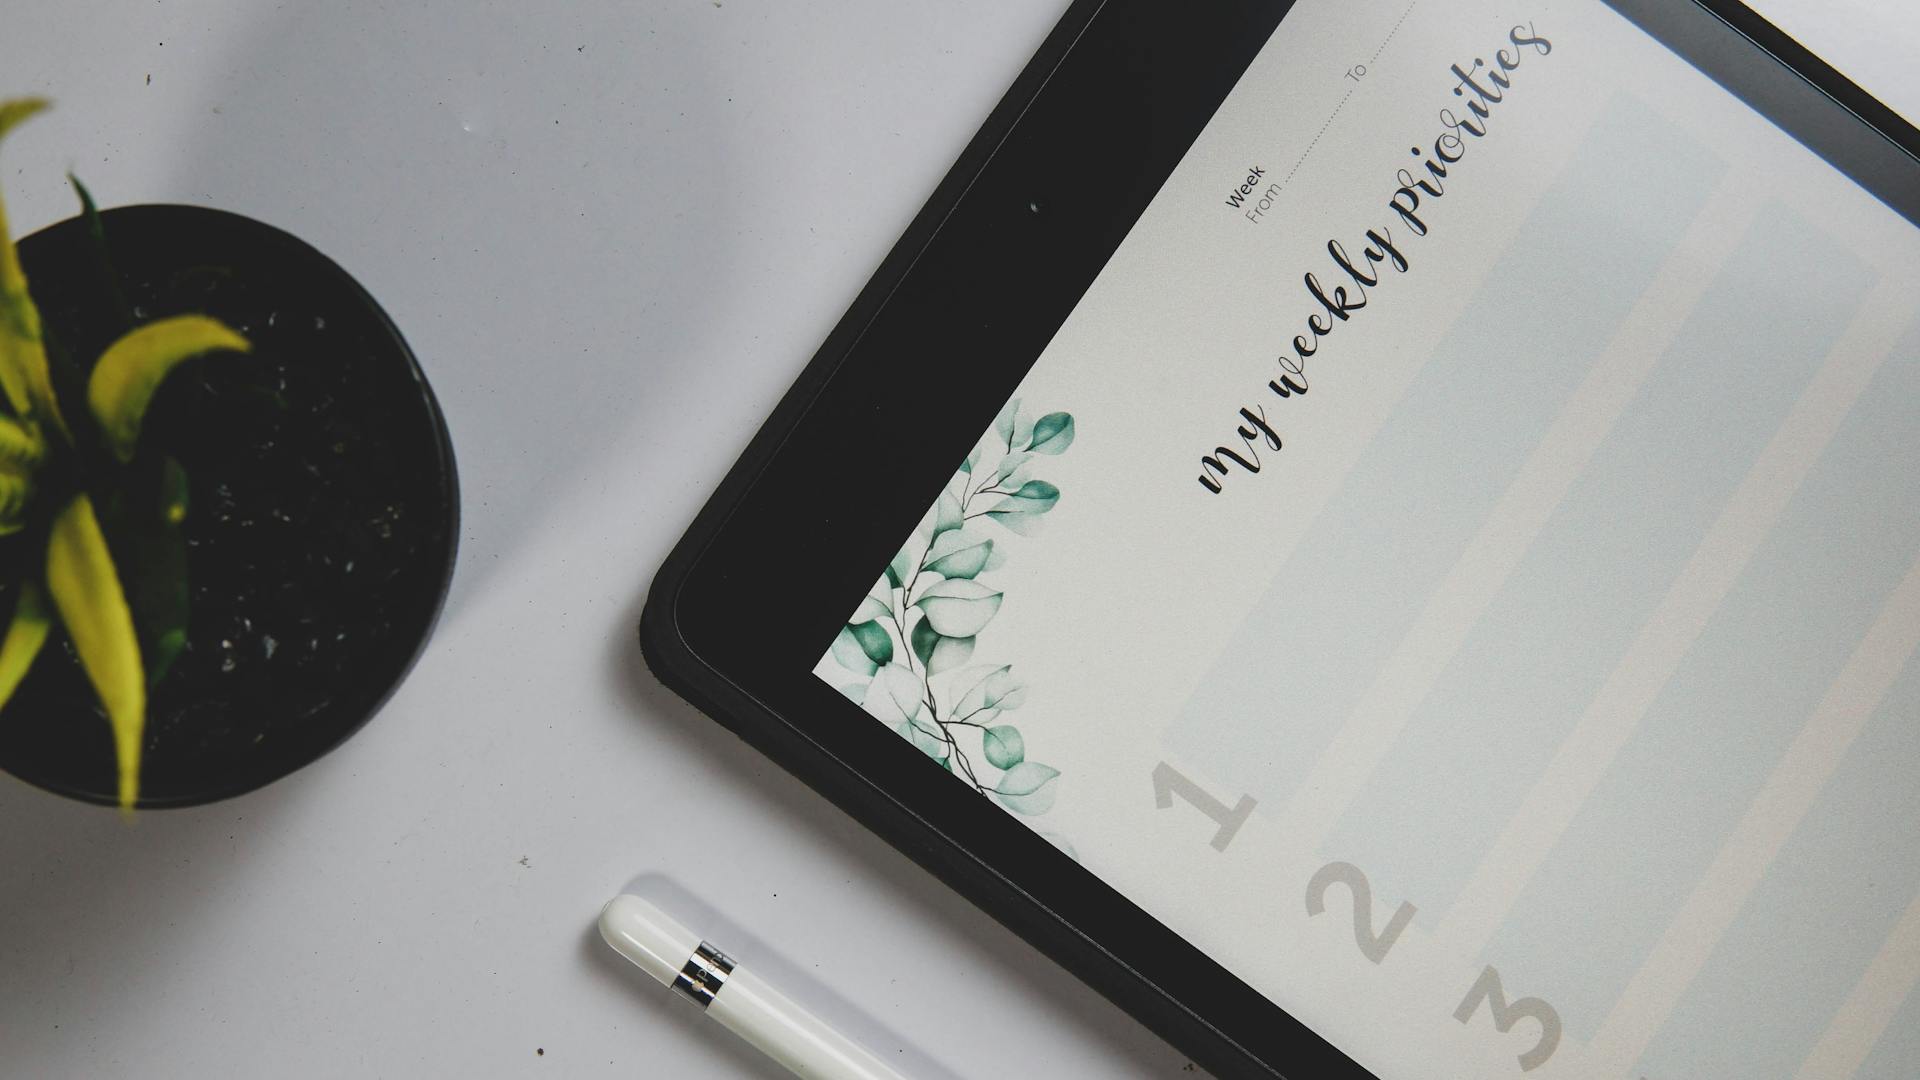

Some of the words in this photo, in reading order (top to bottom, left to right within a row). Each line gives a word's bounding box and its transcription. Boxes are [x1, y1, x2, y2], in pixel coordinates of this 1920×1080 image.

[1226, 165, 1265, 210] Week
[1245, 182, 1282, 224] From
[1344, 63, 1367, 83] To
[1268, 226, 1408, 398] weekly
[1389, 21, 1552, 236] priorities
[1151, 760, 1258, 853] 1
[1305, 861, 1418, 965] 2
[1452, 964, 1562, 1073] 3
